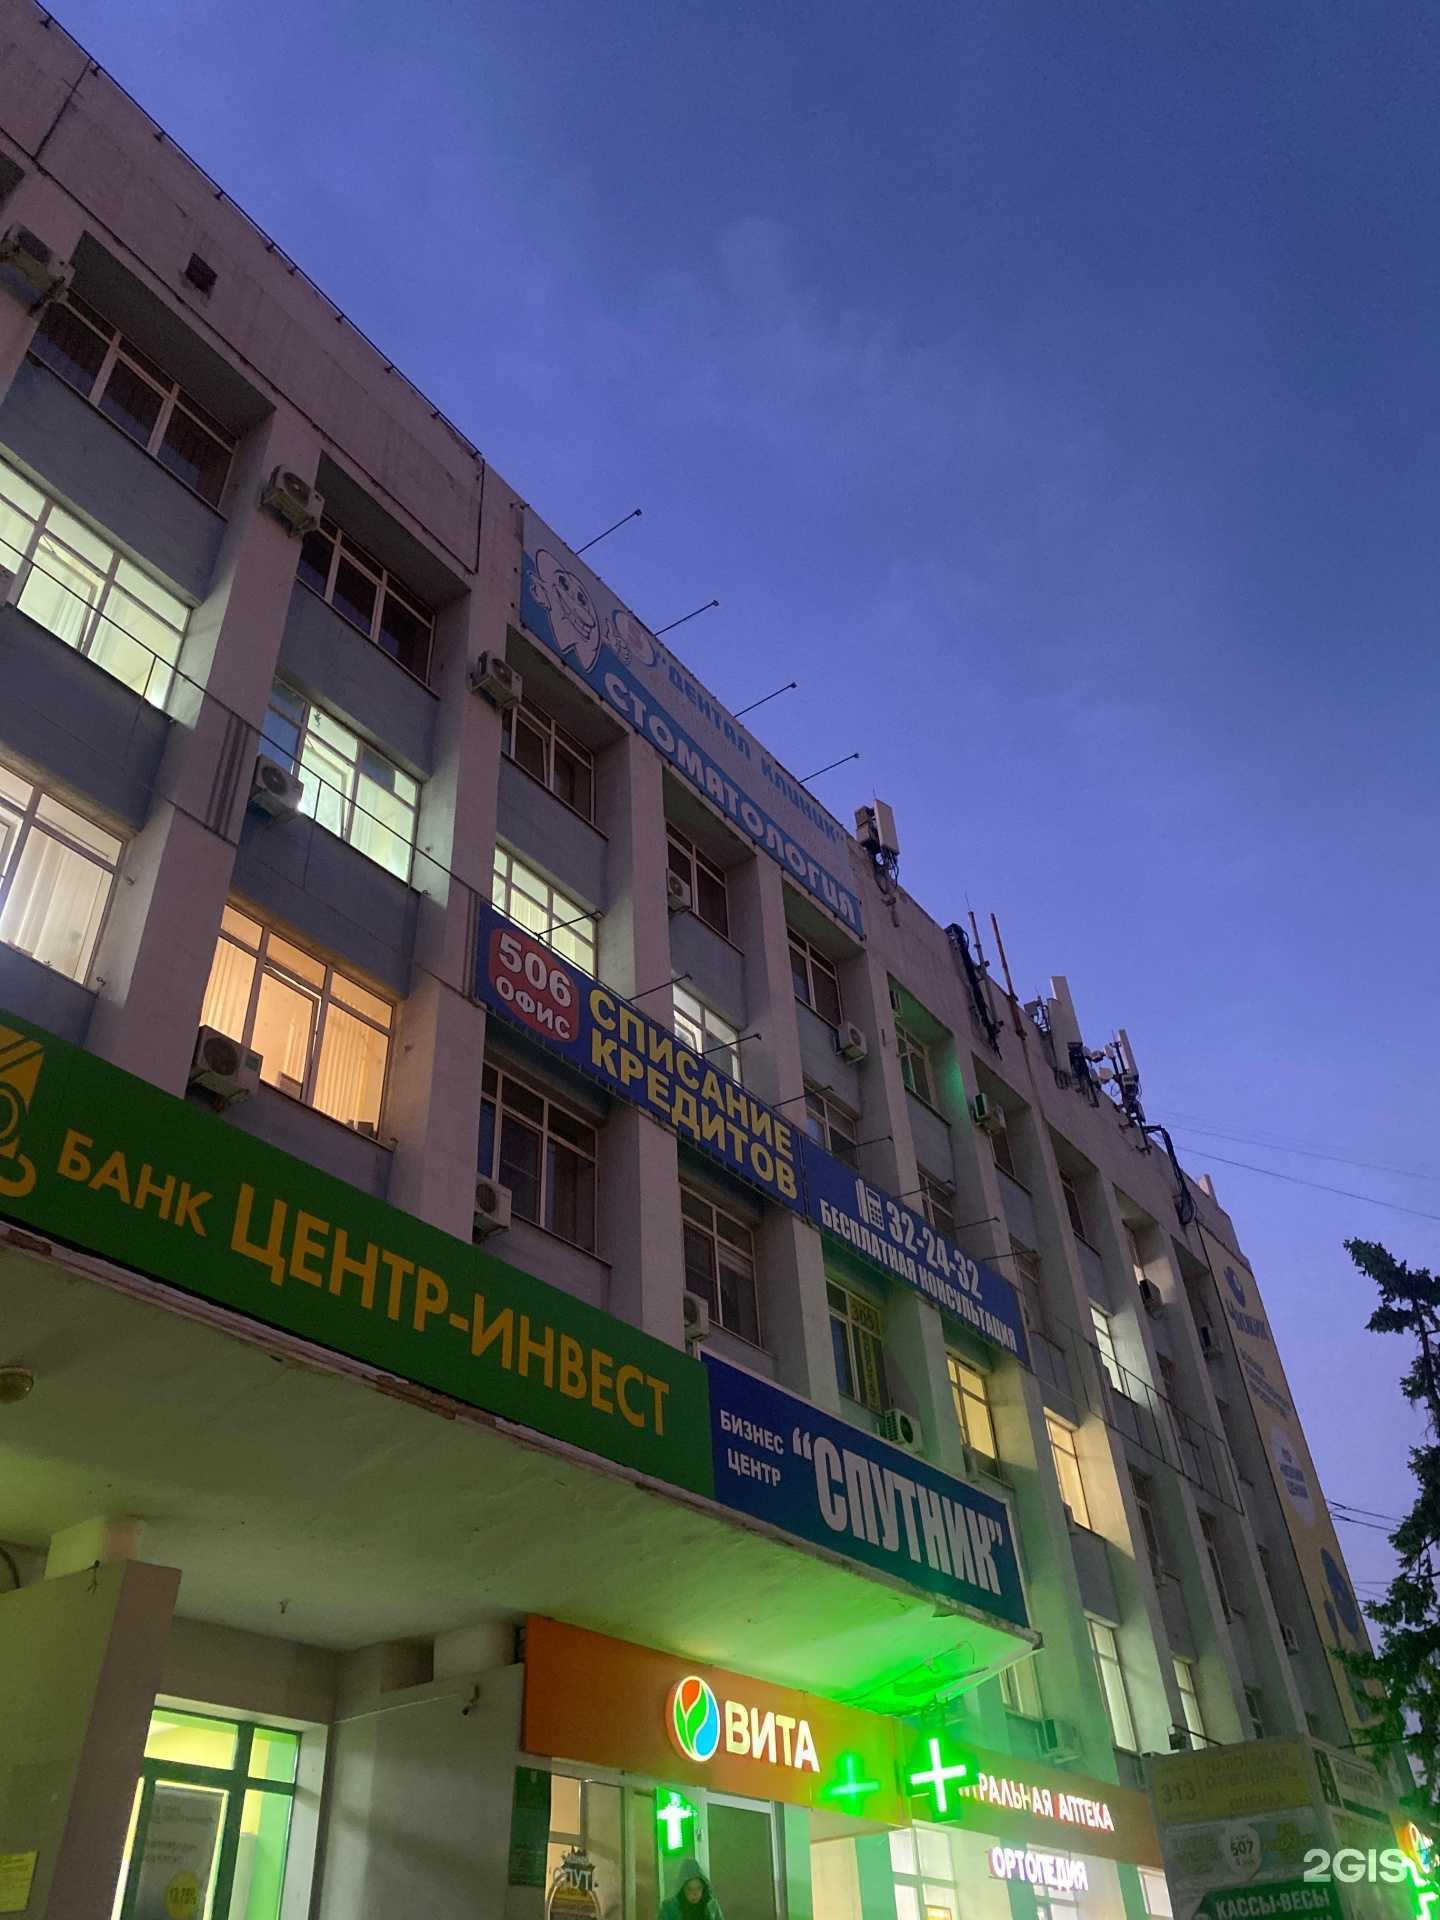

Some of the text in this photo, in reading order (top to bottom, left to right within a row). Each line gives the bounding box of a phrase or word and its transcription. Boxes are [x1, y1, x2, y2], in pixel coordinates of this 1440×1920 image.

[604, 672, 855, 925] СТОМАТОЛОГИЯ
[496, 976, 571, 1039] ОФИС
[499, 932, 571, 1008] 506
[590, 989, 794, 1161] СПИСАНИЕ
[591, 1028, 797, 1200] КРЕДИТОВ
[57, 1129, 213, 1237] БАНК
[230, 1184, 670, 1436] ЦЕНТР-ИНВЕСТ
[819, 1198, 1018, 1353] БЕСПЛАТНАЯ КОНСУЛЬТАЦИЯ
[886, 1200, 982, 1299] 32-24-32
[720, 1409, 784, 1455] БИЗНЕС
[727, 1450, 781, 1487] ЦЕНТР
[725, 1701, 820, 1773] ВИТА
[1059, 1793, 1115, 1832] АПТЕКА
[990, 1847, 1088, 1891] ОРТОПЕДИЯ
